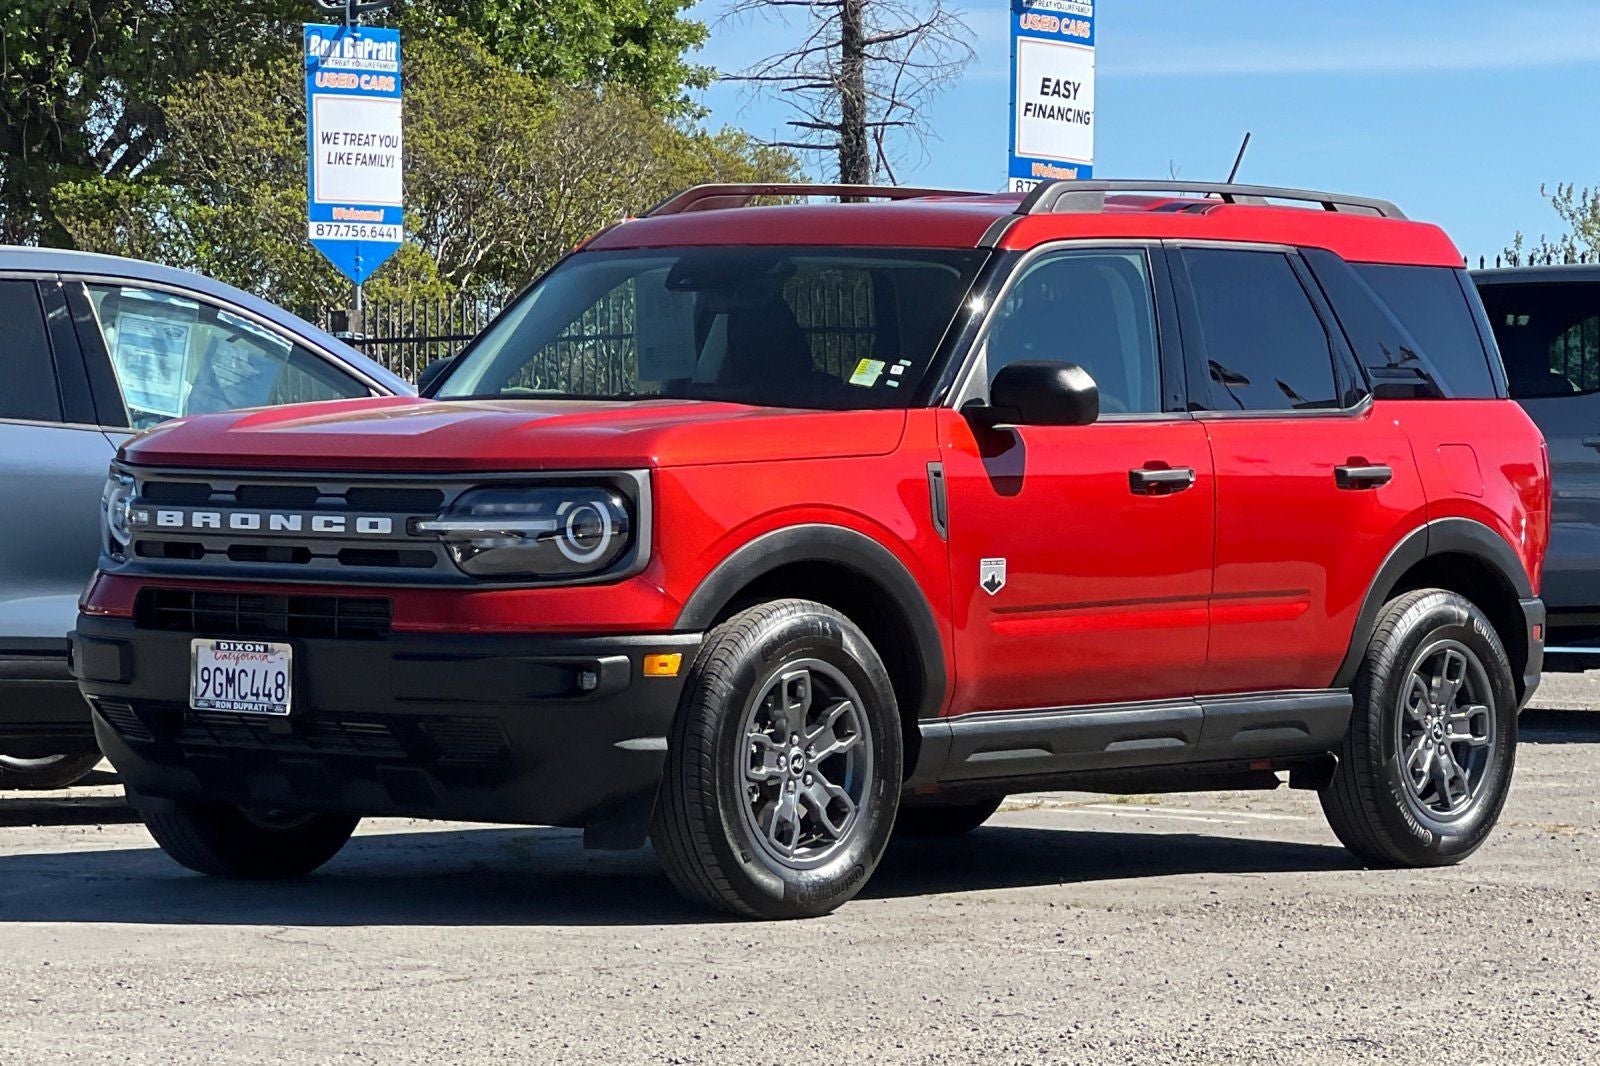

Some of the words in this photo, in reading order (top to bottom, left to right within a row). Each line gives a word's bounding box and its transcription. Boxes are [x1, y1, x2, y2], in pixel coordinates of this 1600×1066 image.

[1019, 13, 1060, 33] USED
[1060, 17, 1091, 39] CARS
[309, 34, 341, 57] Ron
[343, 36, 397, 60] DuPratt
[331, 59, 350, 67] TREAT
[351, 60, 364, 68] YOU
[315, 72, 359, 88] USED
[360, 74, 395, 91] CARS
[1040, 76, 1081, 101] EASY
[1024, 102, 1091, 126] FINANCING
[321, 131, 340, 145] WE
[343, 132, 377, 147] TREAT
[378, 134, 399, 149] YOU
[327, 151, 353, 166] LIKE
[354, 152, 395, 168] FAMILY!
[316, 223, 397, 239] 877.756.6441
[156, 510, 393, 534] BRONCO
[219, 642, 265, 652] DIXON
[214, 651, 274, 666] California
[200, 666, 286, 702] 9GMC448
[215, 700, 232, 709] RON
[233, 701, 268, 712] DUPRATT
